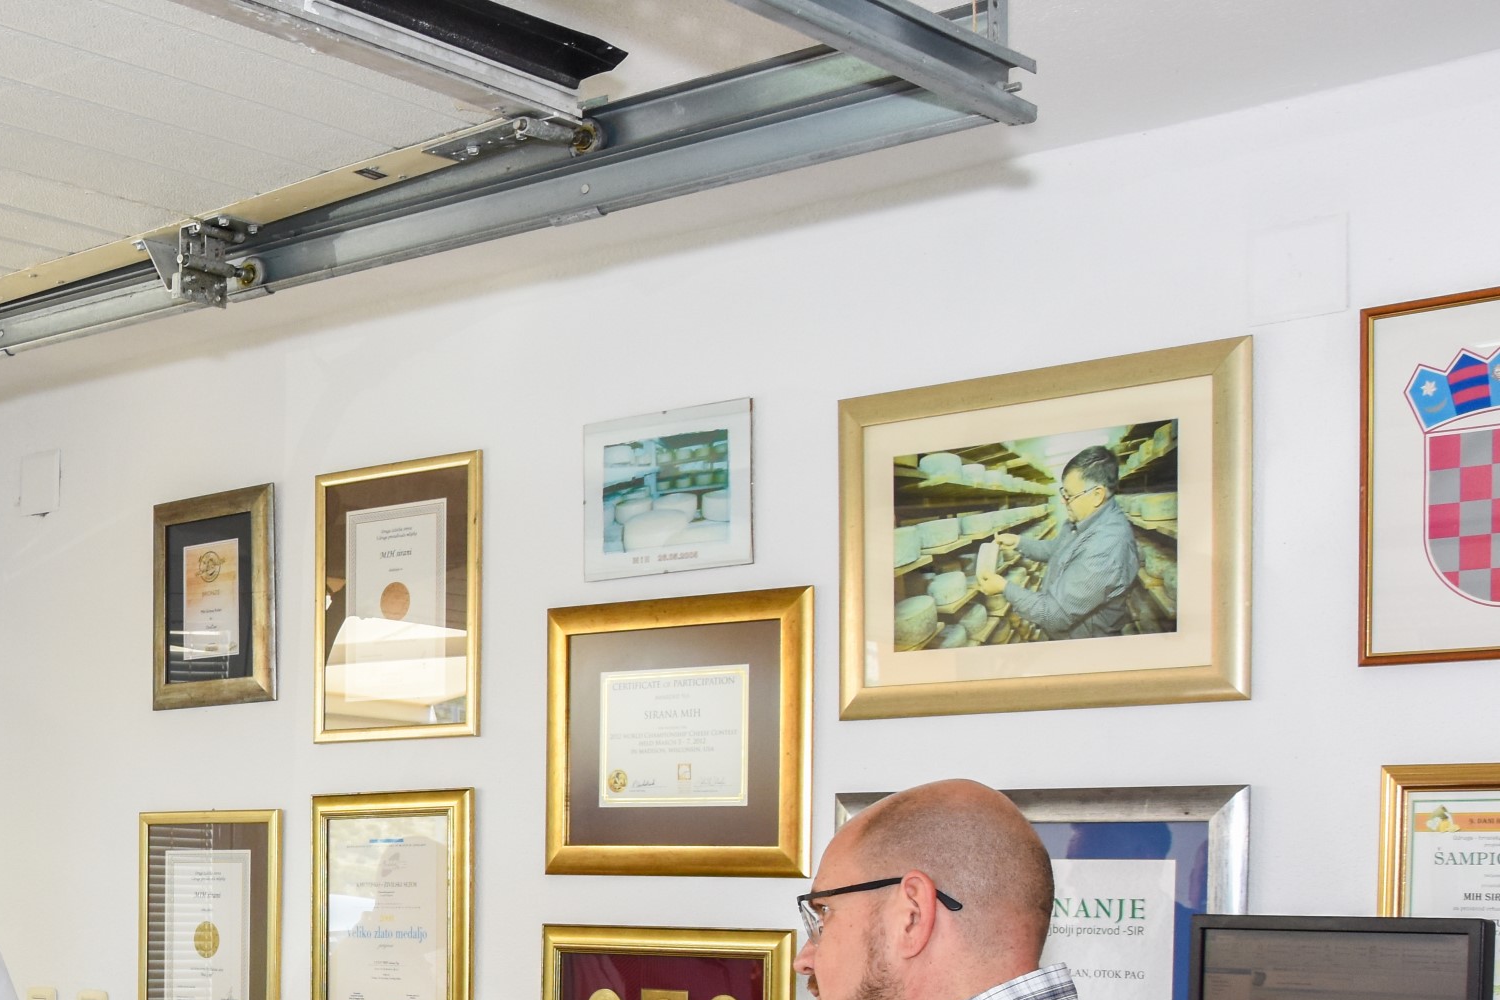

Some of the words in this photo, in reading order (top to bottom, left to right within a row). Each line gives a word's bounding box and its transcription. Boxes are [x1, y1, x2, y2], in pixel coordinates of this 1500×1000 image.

[612, 681, 661, 691] CERTIFICATE
[673, 676, 735, 688] PARTICIPATION
[644, 710, 678, 720] SIRANA
[680, 708, 701, 718] MIH
[1463, 892, 1482, 901] MIH
[374, 925, 393, 939] zlato
[1076, 924, 1120, 937] proizvod
[1093, 969, 1122, 979] OTOK
[1124, 970, 1145, 980] PAG
